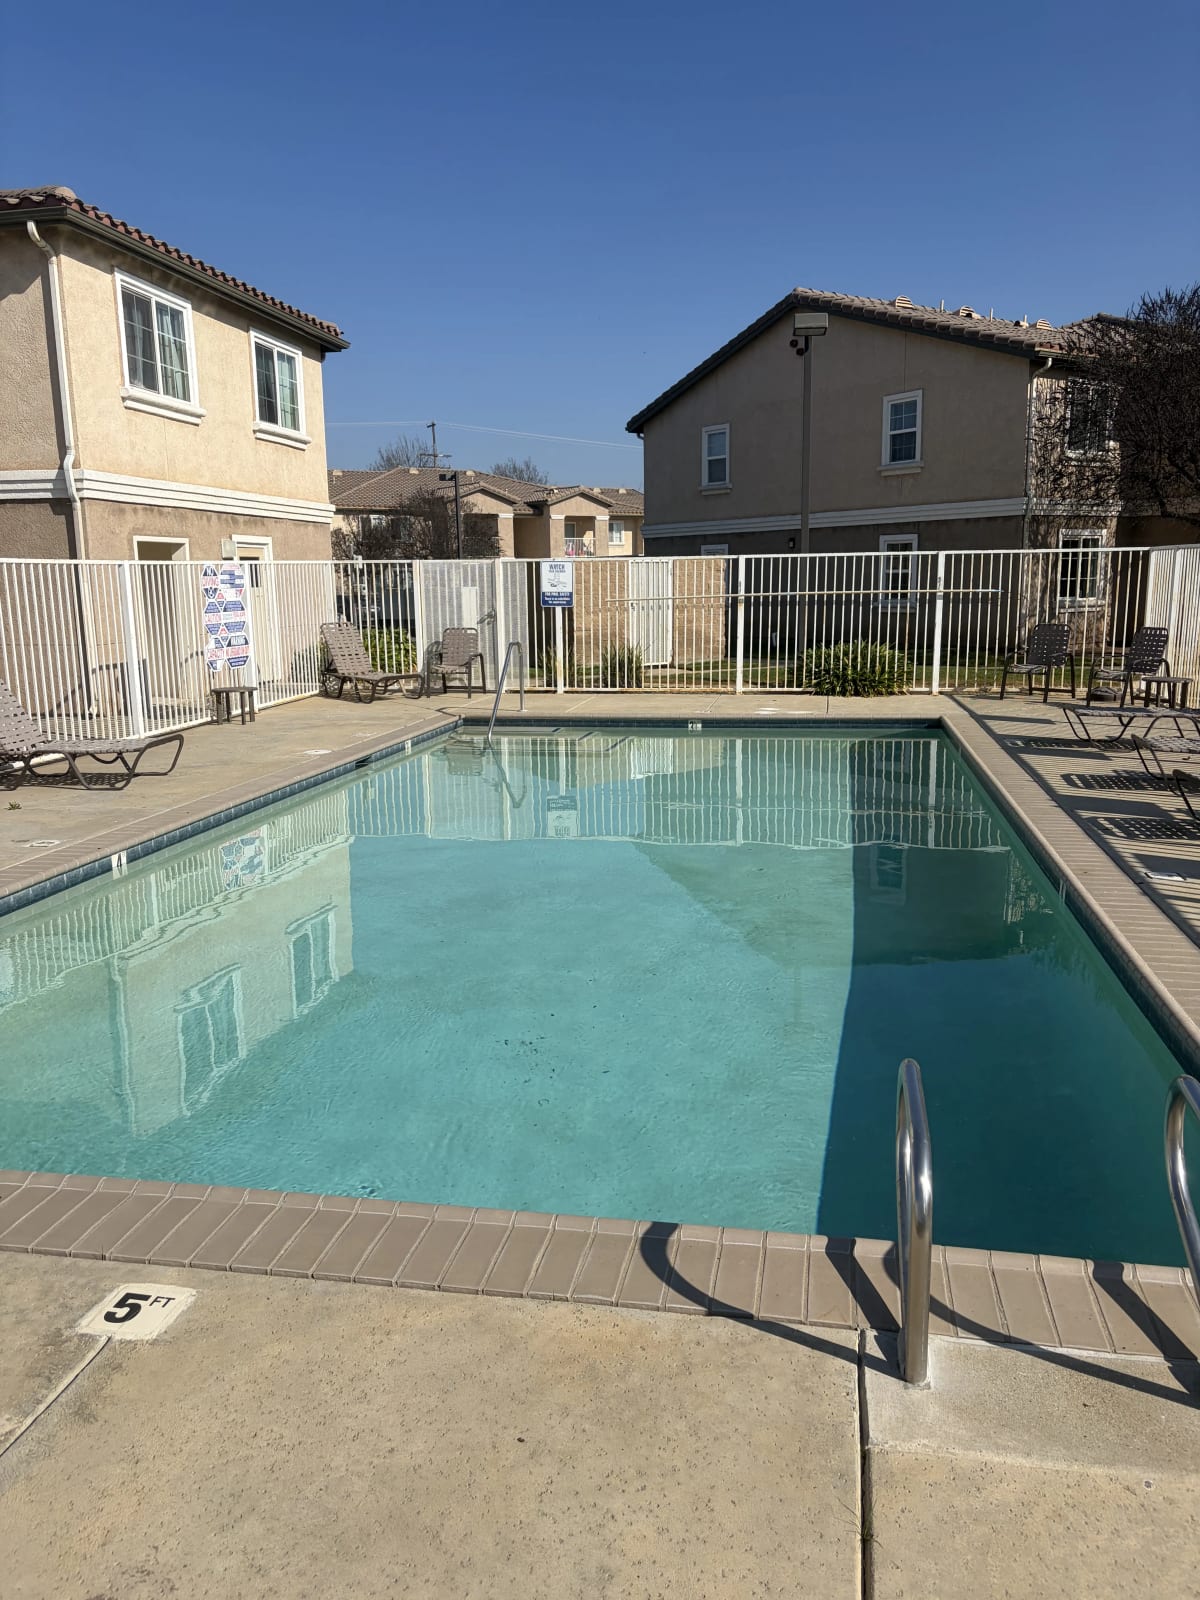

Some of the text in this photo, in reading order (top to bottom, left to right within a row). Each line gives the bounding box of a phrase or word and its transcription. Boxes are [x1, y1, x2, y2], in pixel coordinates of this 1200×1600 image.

[206, 567, 214, 576] NO
[202, 577, 220, 587] DIVING
[103, 1292, 176, 1324] 5 FT
